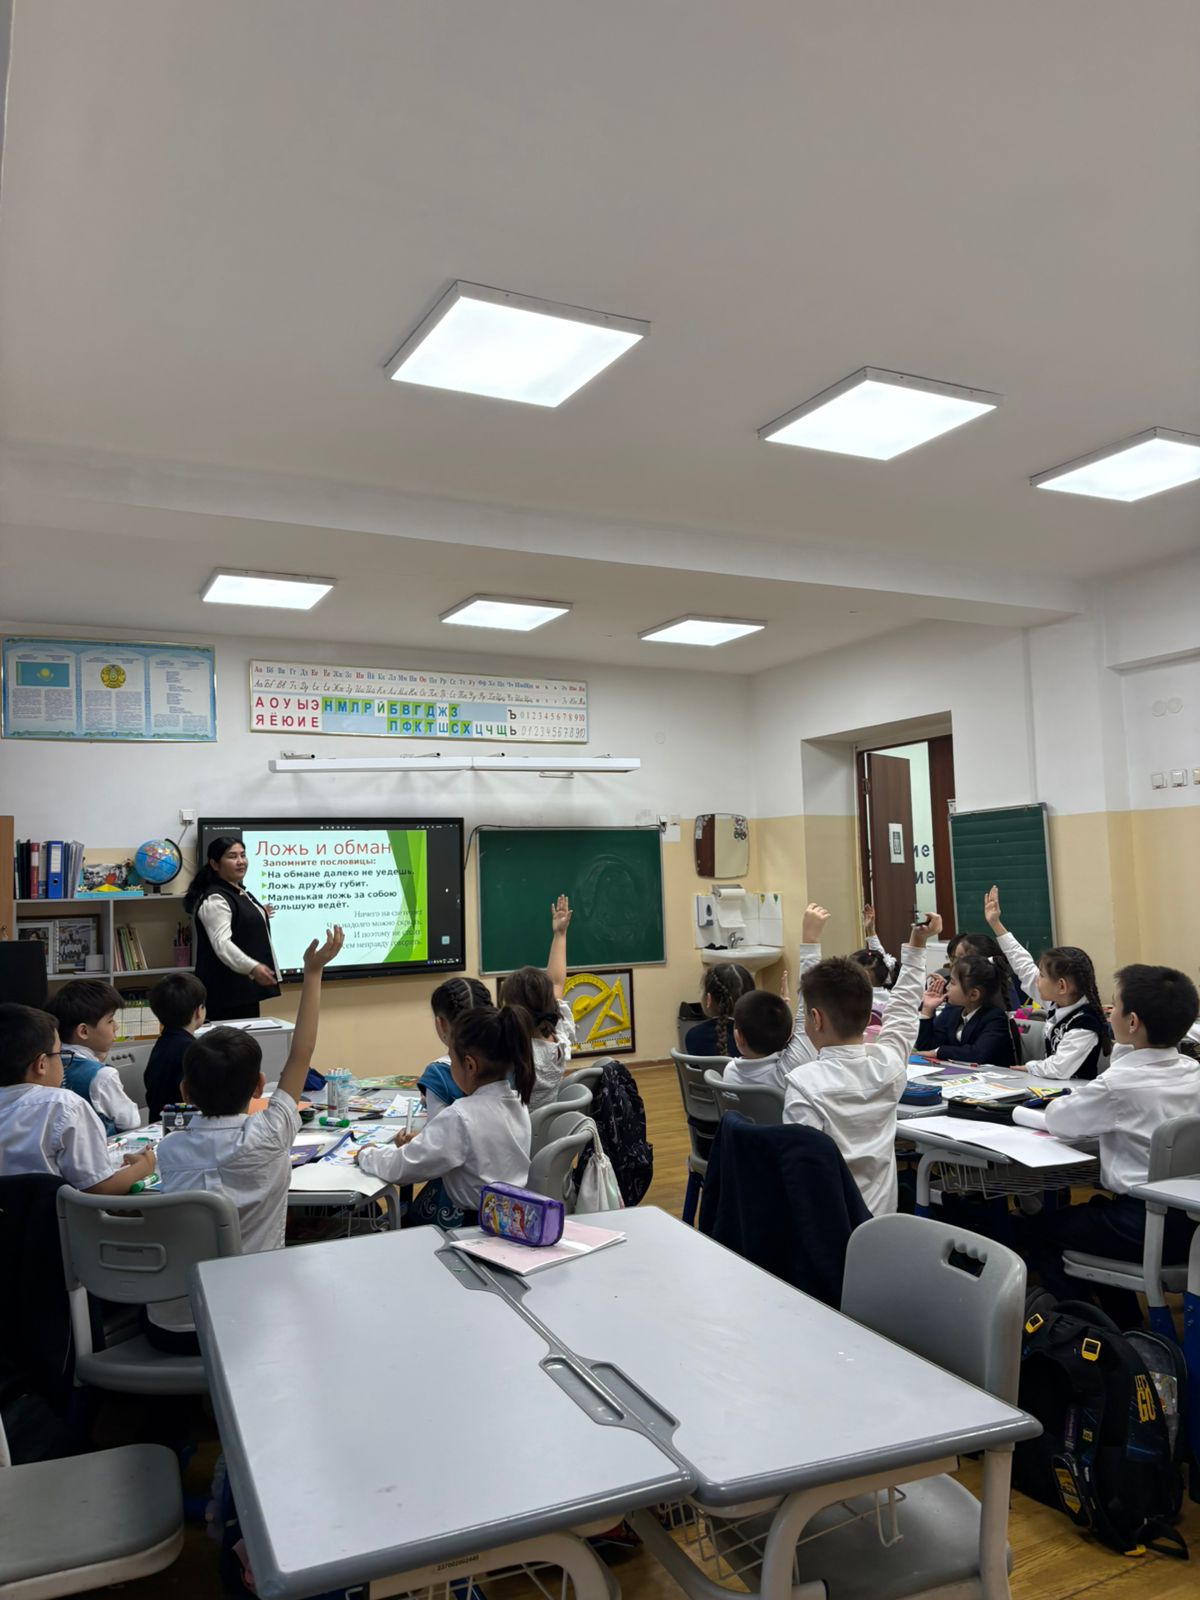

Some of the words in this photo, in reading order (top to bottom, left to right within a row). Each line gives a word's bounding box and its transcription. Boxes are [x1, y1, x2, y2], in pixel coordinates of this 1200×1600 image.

[256, 841, 309, 856] Ложь
[316, 844, 326, 855] и
[334, 840, 392, 855] обман
[376, 869, 414, 877] уедешь.
[298, 880, 336, 890] дружбу
[340, 880, 368, 889] губит.
[318, 900, 349, 908] ведёт.
